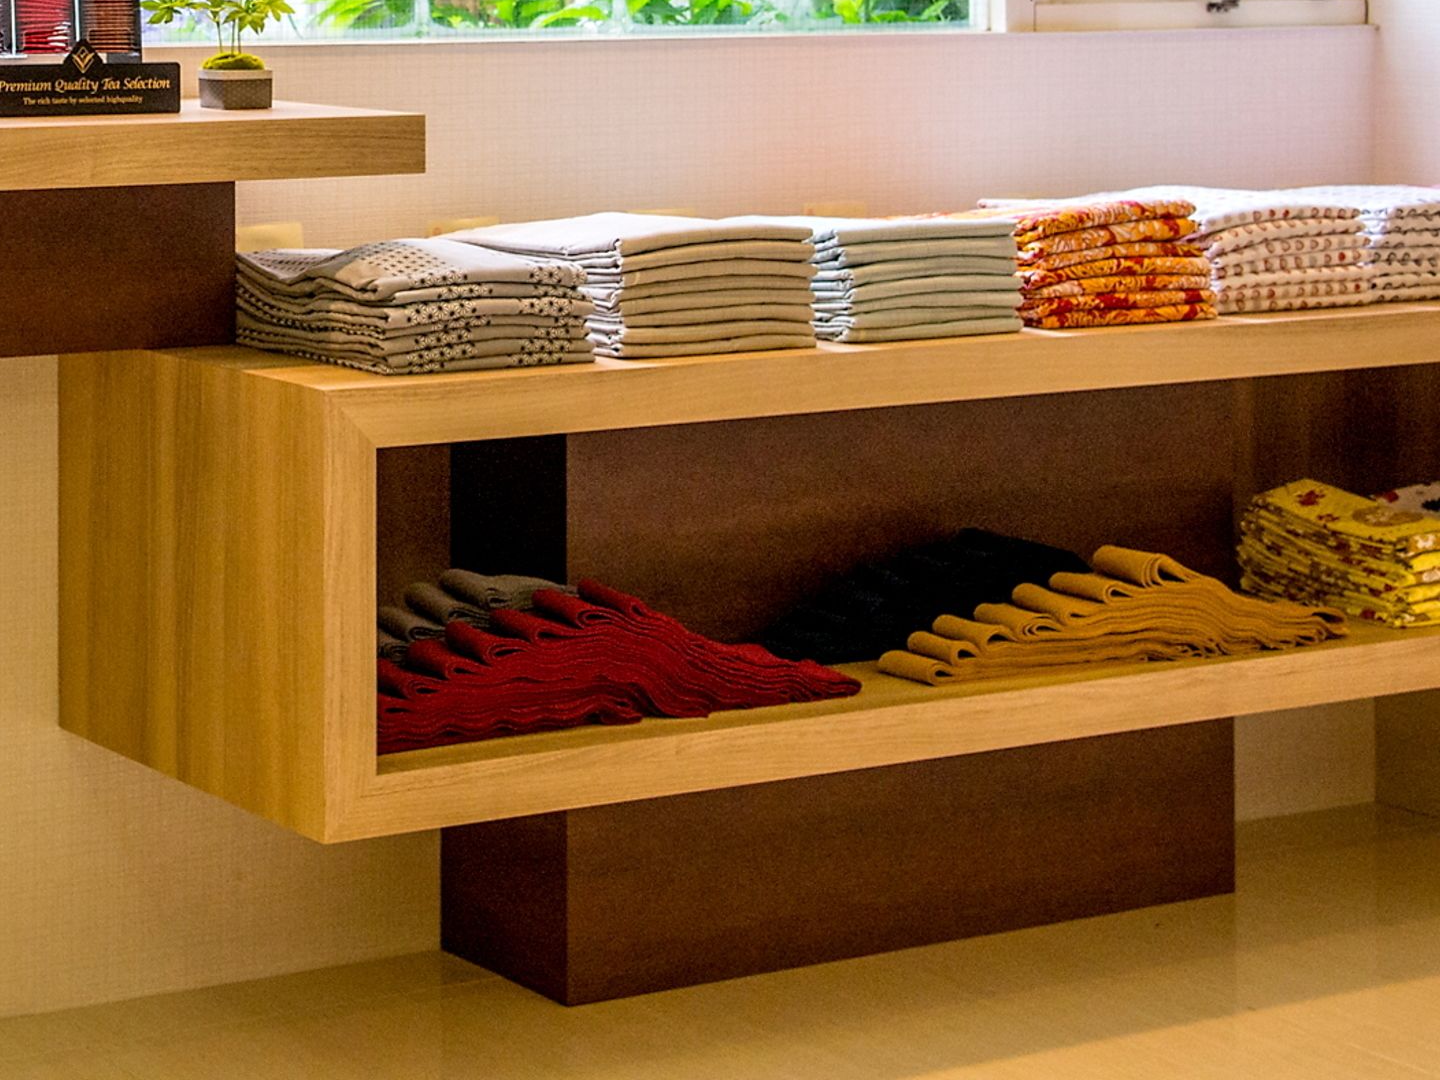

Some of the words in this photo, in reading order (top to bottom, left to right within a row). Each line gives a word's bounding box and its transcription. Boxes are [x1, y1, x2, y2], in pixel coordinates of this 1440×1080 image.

[55, 77, 99, 94] Quality
[101, 78, 121, 91] Tea
[123, 76, 171, 90] Selection
